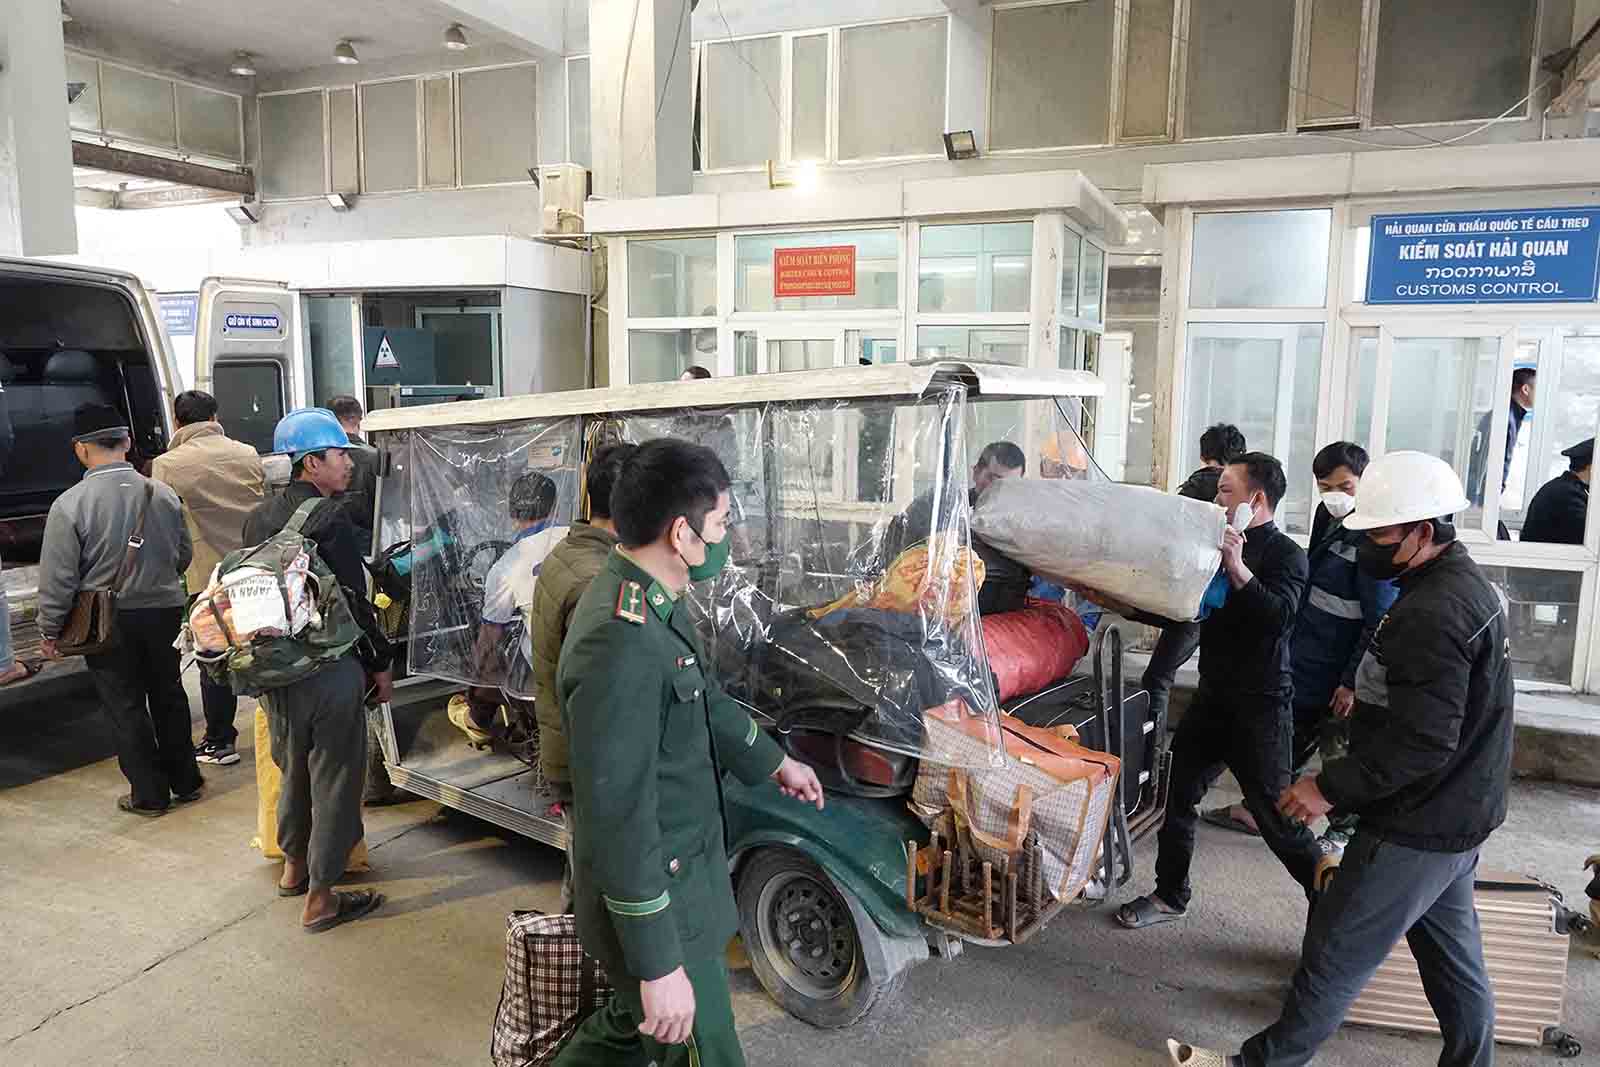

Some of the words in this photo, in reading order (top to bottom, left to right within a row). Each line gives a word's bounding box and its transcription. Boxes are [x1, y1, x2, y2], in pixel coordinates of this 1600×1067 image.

[1385, 220, 1402, 235] HẢI
[1405, 223, 1432, 236] QUAN
[1435, 219, 1456, 233] CỬA
[1459, 218, 1487, 232] KHẨU
[1490, 218, 1518, 232] QUỐC
[1521, 217, 1535, 230] TẾ
[1561, 217, 1589, 228] TREO
[1399, 238, 1439, 260] KIỂM
[1443, 239, 1485, 258] SOÁT
[1489, 237, 1517, 257] HẢI
[1522, 239, 1568, 258] QUAN
[1396, 283, 1476, 296] CUSTOMS
[1480, 282, 1564, 295] CONTROL
